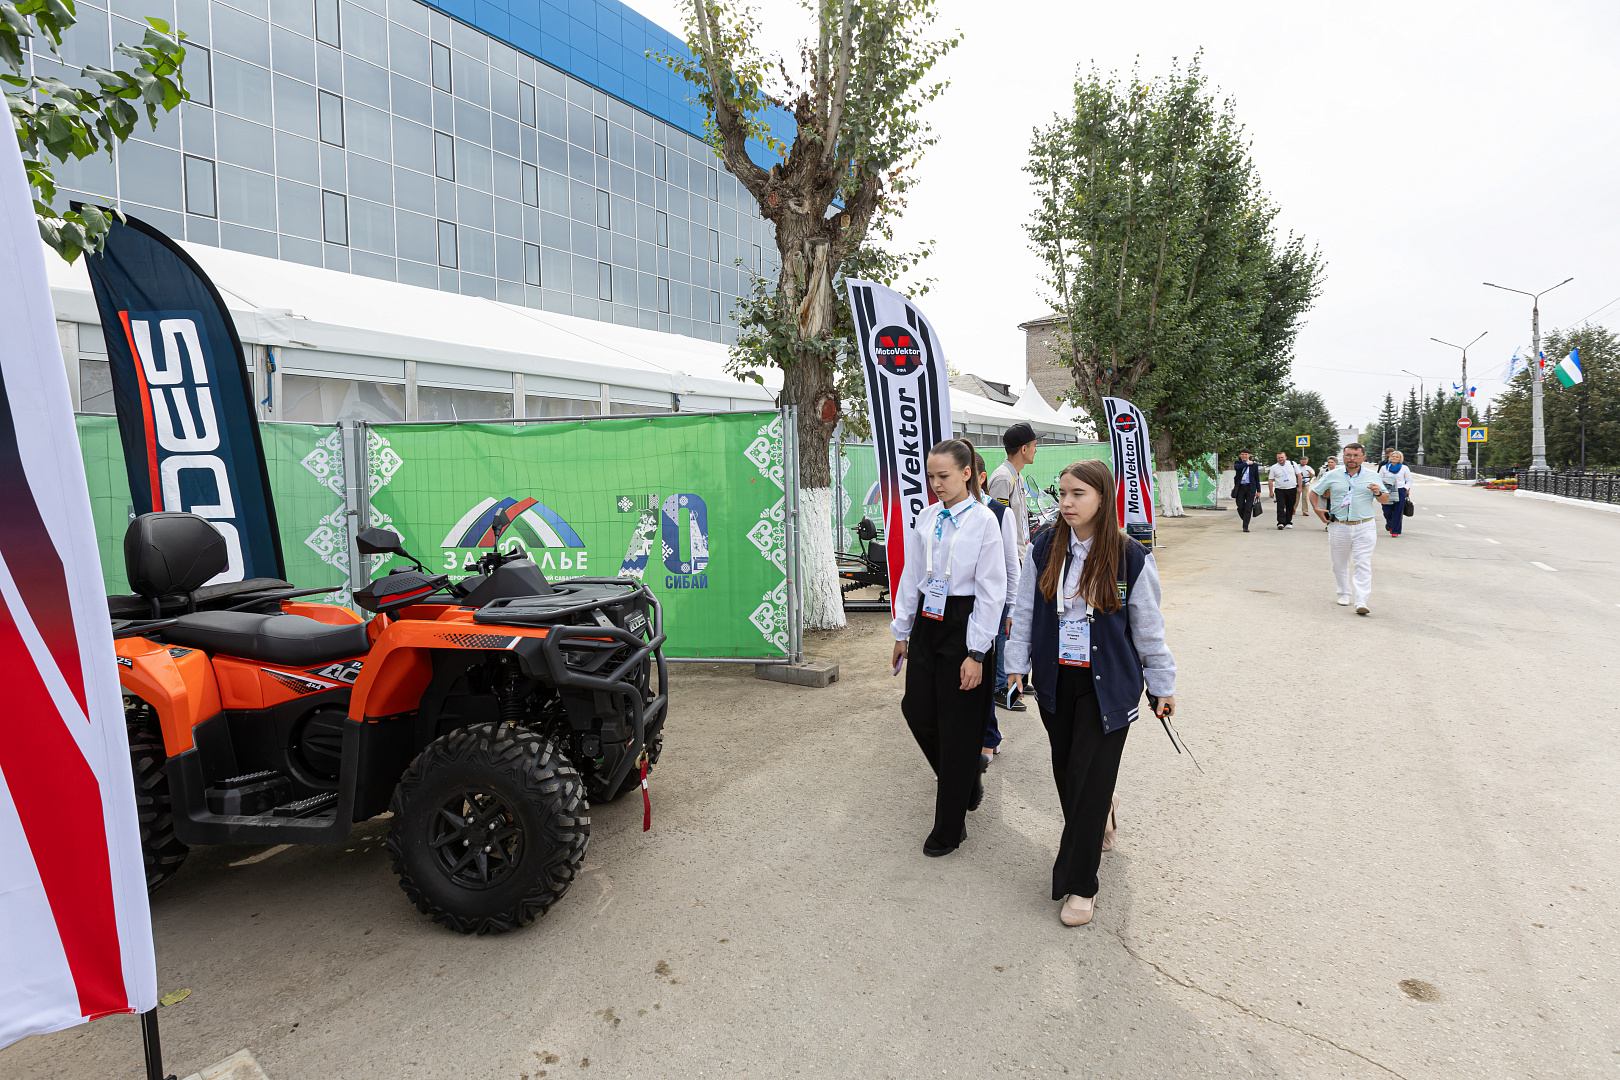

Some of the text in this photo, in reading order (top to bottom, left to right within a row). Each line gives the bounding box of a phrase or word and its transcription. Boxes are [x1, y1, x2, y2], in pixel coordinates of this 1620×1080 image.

[875, 347, 921, 356] MotoVektor
[1125, 437, 1140, 514] MotoVektor
[616, 493, 709, 584] 70
[665, 573, 709, 589] СИБАЙ
